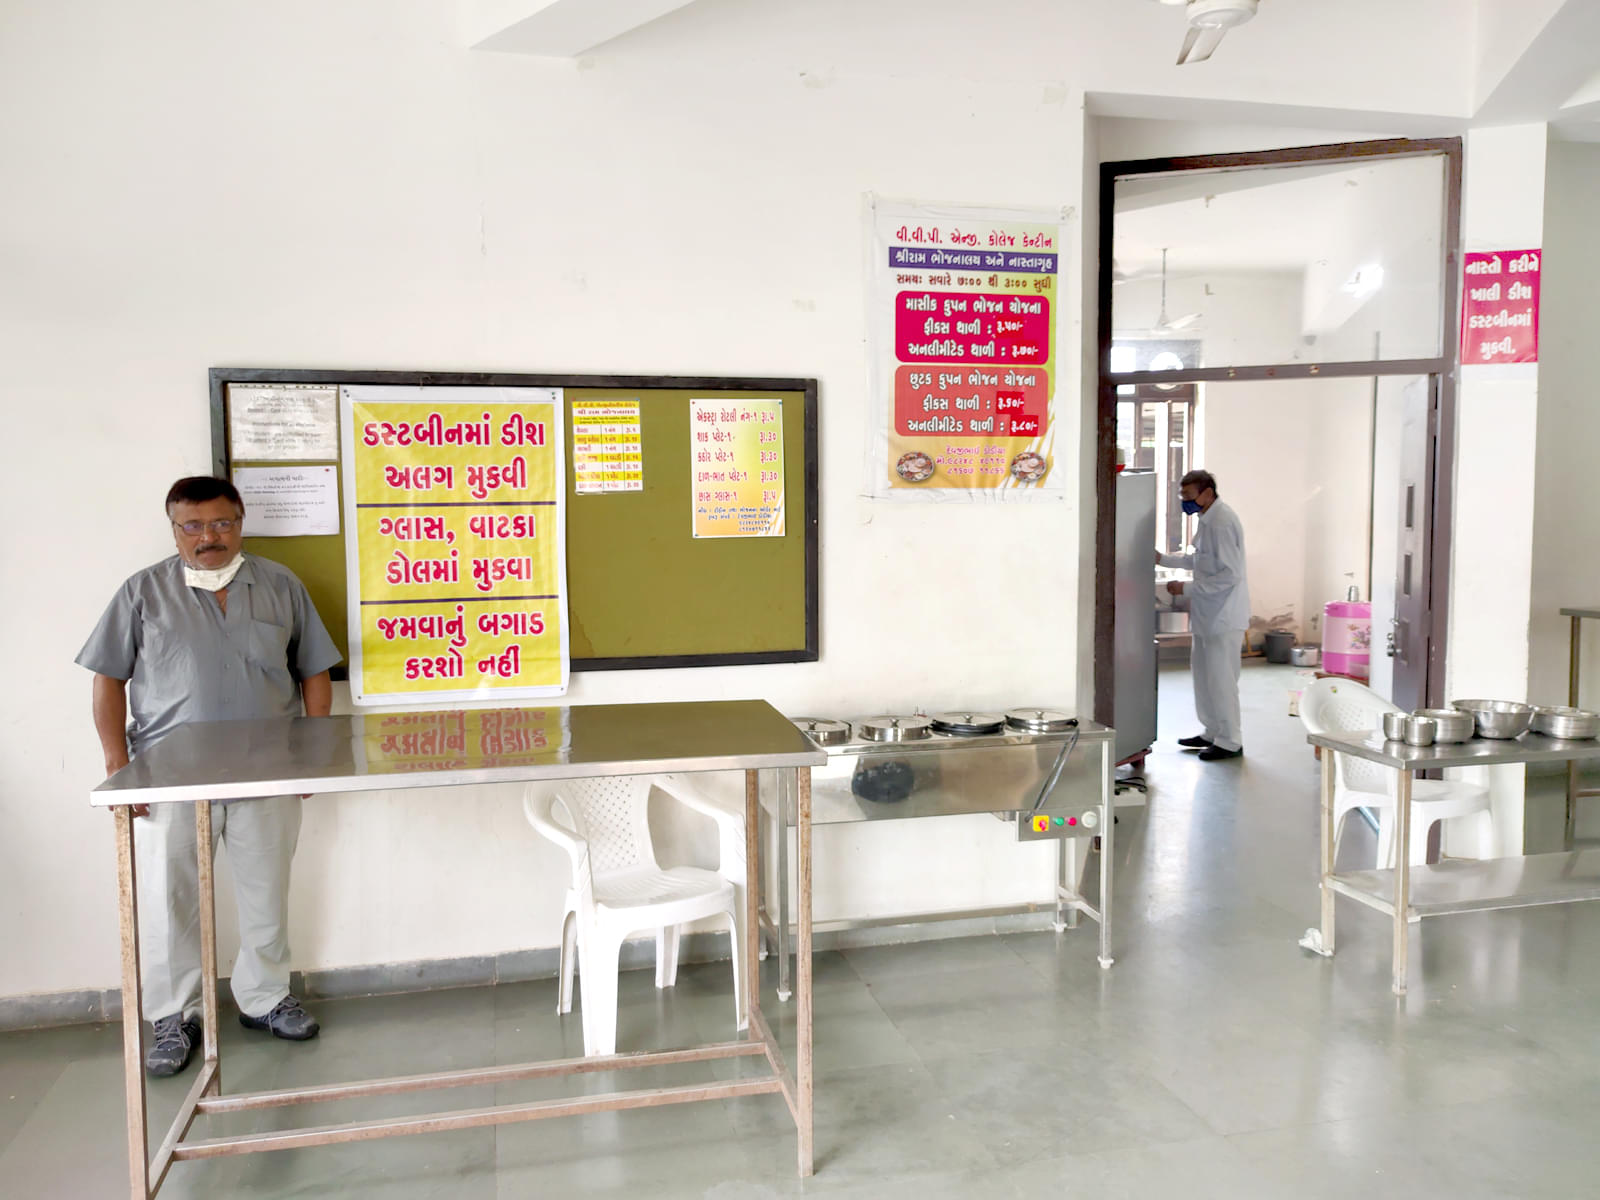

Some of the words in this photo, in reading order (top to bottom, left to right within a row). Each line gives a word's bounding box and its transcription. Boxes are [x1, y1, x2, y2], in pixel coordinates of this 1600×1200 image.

[950, 228, 981, 247] એન્જી.
[988, 229, 1016, 247] કોલેજ
[1022, 231, 1053, 249] કેન્ટીન
[895, 249, 926, 264] શ્રીરામ
[930, 250, 980, 266] ભોજનાલય
[985, 253, 1004, 267] અને
[1008, 256, 1053, 272] નાસ્તાગૃહ
[1508, 253, 1539, 273] કરીને
[928, 272, 952, 286] સવારે
[988, 274, 998, 287] થી
[1033, 278, 1051, 293] સુધી
[1470, 282, 1501, 301] ખાલી
[1507, 281, 1532, 300] ડીશ
[905, 294, 938, 312] માસીક
[943, 298, 967, 317] કુપન
[973, 296, 1004, 313] ભોજન
[1008, 297, 1042, 315] યોજના
[923, 317, 950, 336] ફીકસ
[956, 318, 981, 335] થાળી
[907, 339, 965, 357] અનલીમીટેડ
[970, 340, 995, 358] થાળી
[1480, 336, 1517, 361] મુકવી.
[909, 373, 932, 389] છુટક
[938, 373, 962, 390] કુપન
[968, 369, 998, 386] ભોજન
[1004, 370, 1036, 387] યોજના
[922, 393, 949, 412] ફીકસ
[955, 394, 980, 410] થાળી
[362, 412, 491, 447] ડસ્ટબીનમાં
[500, 413, 546, 447] ડીશ
[907, 415, 964, 432] અનલીમીટેડ
[969, 416, 994, 433] થાળી
[384, 464, 453, 490] અલગ
[466, 456, 527, 499] મુકવી
[379, 515, 455, 544] ગ્લાસ,
[468, 514, 535, 539] વાટકા
[386, 549, 459, 584] ડોલમાં
[472, 556, 532, 592] મુકવા
[377, 605, 469, 647] જમવાનું
[477, 611, 546, 637] બગાડ
[405, 647, 464, 680] કરશો
